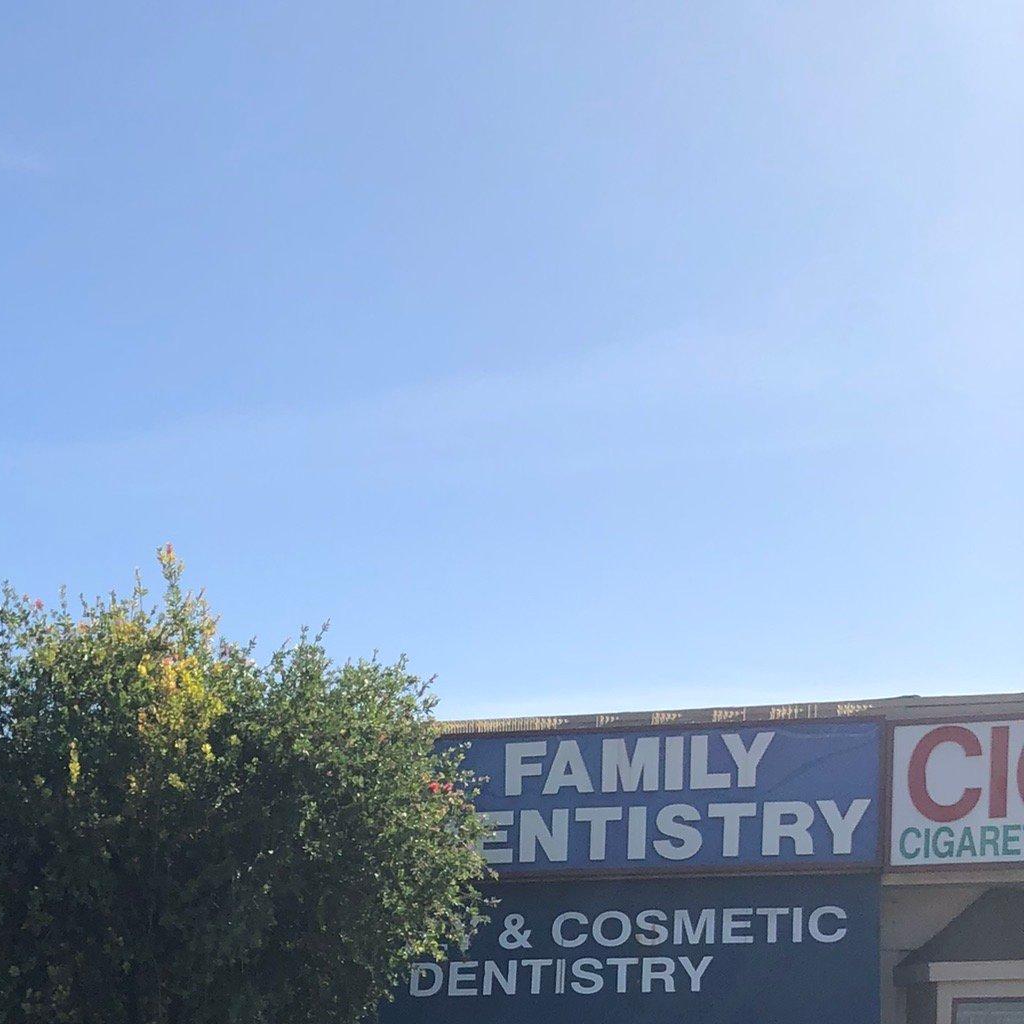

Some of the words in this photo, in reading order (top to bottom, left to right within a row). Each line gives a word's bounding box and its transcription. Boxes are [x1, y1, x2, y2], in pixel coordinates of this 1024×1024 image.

[505, 732, 775, 796] FAMILY
[907, 725, 1024, 823] CI
[475, 799, 872, 864] ENTISTRY
[899, 824, 1024, 859] CIGARE
[498, 913, 533, 949] &
[551, 905, 848, 948] COSMETIC
[409, 956, 715, 997] DENTISTRY
